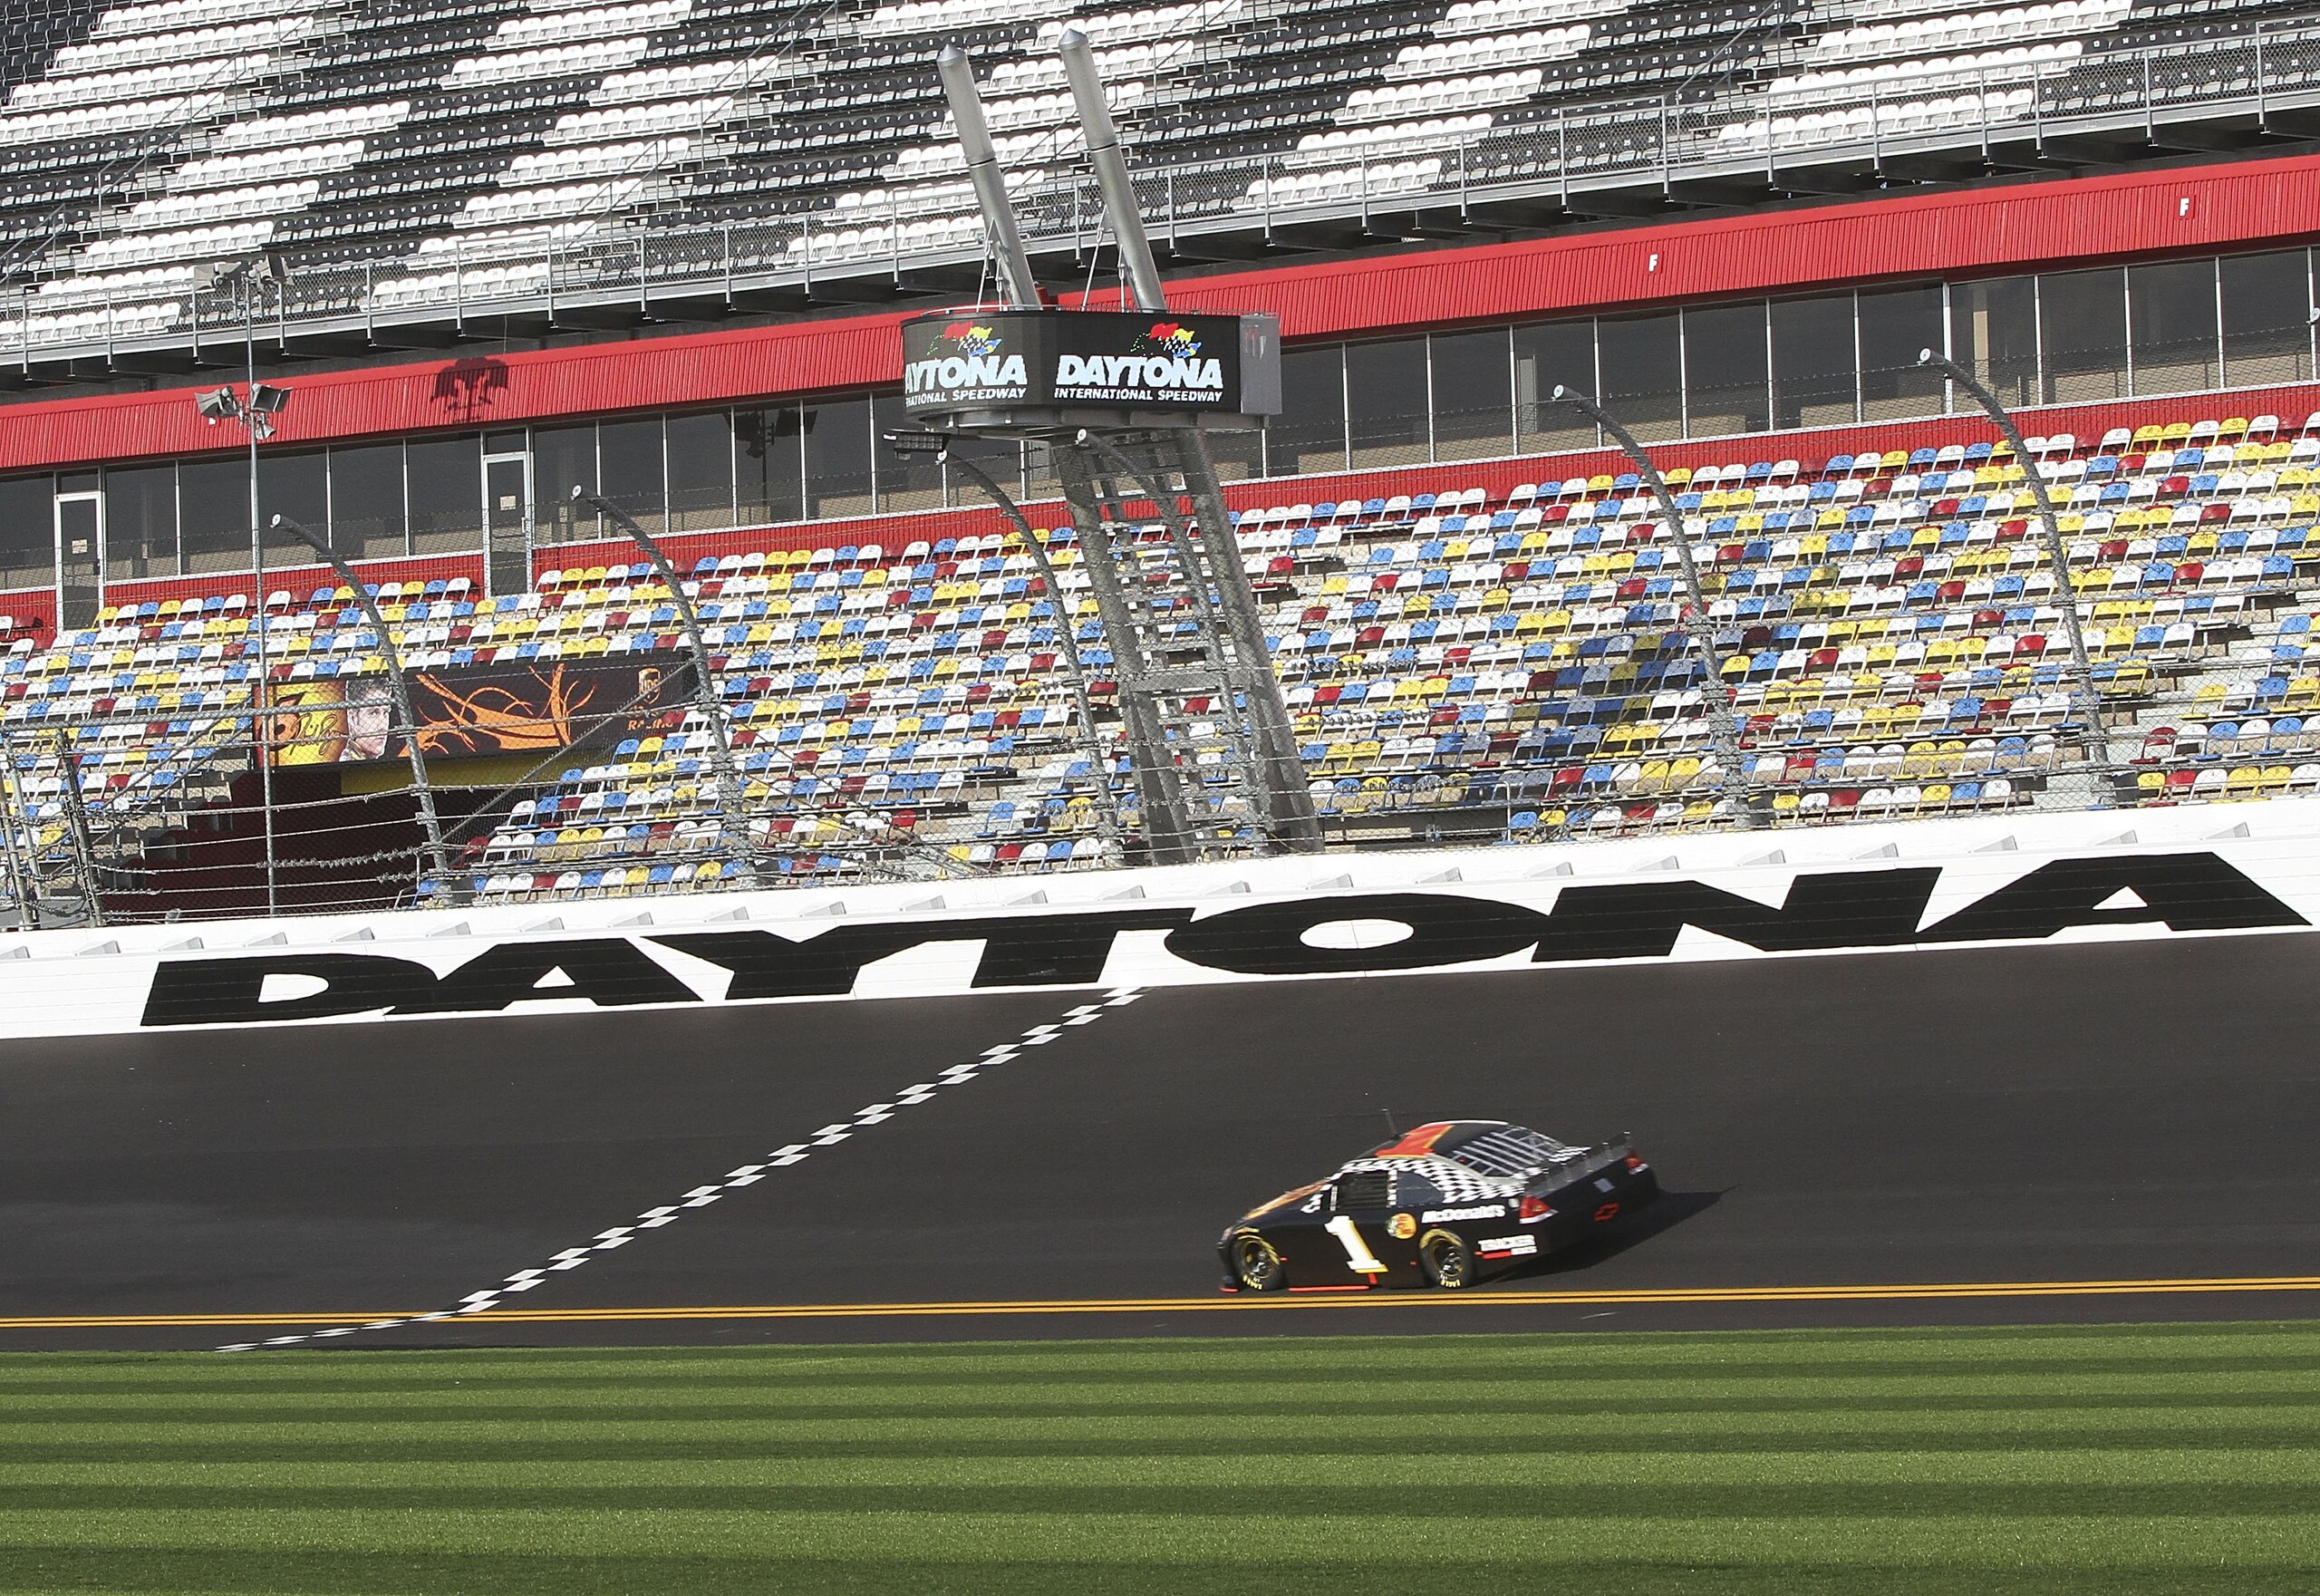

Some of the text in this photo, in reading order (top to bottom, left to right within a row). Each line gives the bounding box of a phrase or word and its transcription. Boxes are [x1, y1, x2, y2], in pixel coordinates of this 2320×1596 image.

[2180, 198, 2190, 218] F
[1648, 254, 1659, 272] F
[1056, 354, 1223, 389] DAYTONA
[952, 388, 1027, 401] SPEEDWAY
[1054, 387, 1223, 402] INTERNATIONAL SPEEDWAY
[140, 852, 2313, 1026] DAYTONA
[1323, 1215, 1389, 1273] 1
